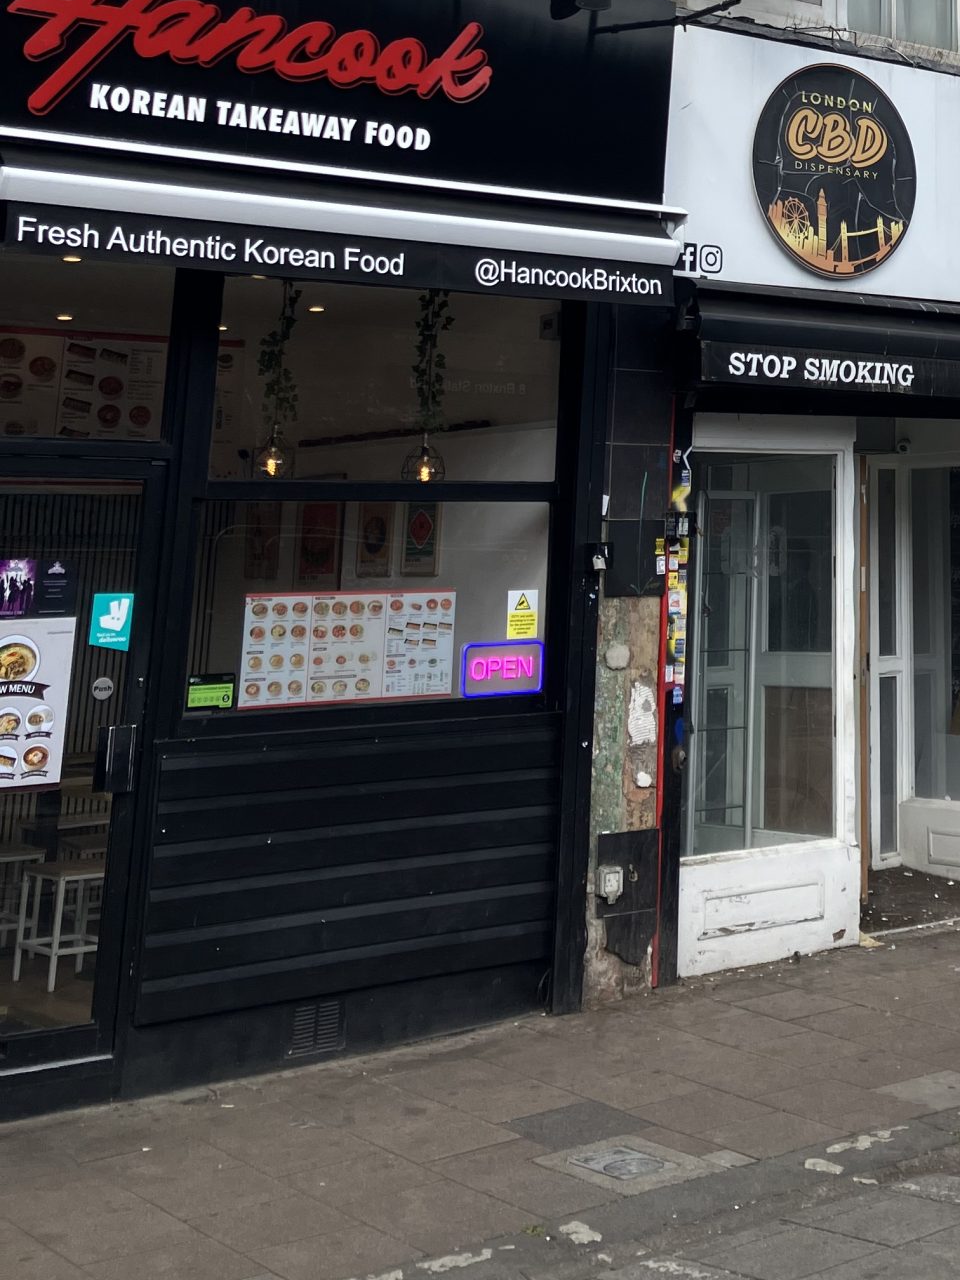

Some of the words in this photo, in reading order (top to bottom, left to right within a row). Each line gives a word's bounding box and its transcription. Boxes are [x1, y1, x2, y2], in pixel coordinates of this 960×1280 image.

[89, 83, 207, 123] KOREAN
[216, 100, 357, 142] TAKEAWAY
[364, 120, 432, 151] FOOD
[801, 91, 872, 114] LONDON
[785, 106, 888, 168] CBD
[794, 160, 878, 180] DISPENSARY
[17, 216, 101, 249] Fresh
[106, 225, 237, 260] Authentic
[243, 238, 335, 270] Korean
[344, 247, 405, 276] Food
[474, 258, 663, 296] @HancookBrixton
[727, 352, 797, 380] STOP
[803, 358, 915, 387] SMOKING
[470, 656, 534, 682] OPEN
[8, 683, 36, 695] MENU
[93, 684, 113, 693] Push
